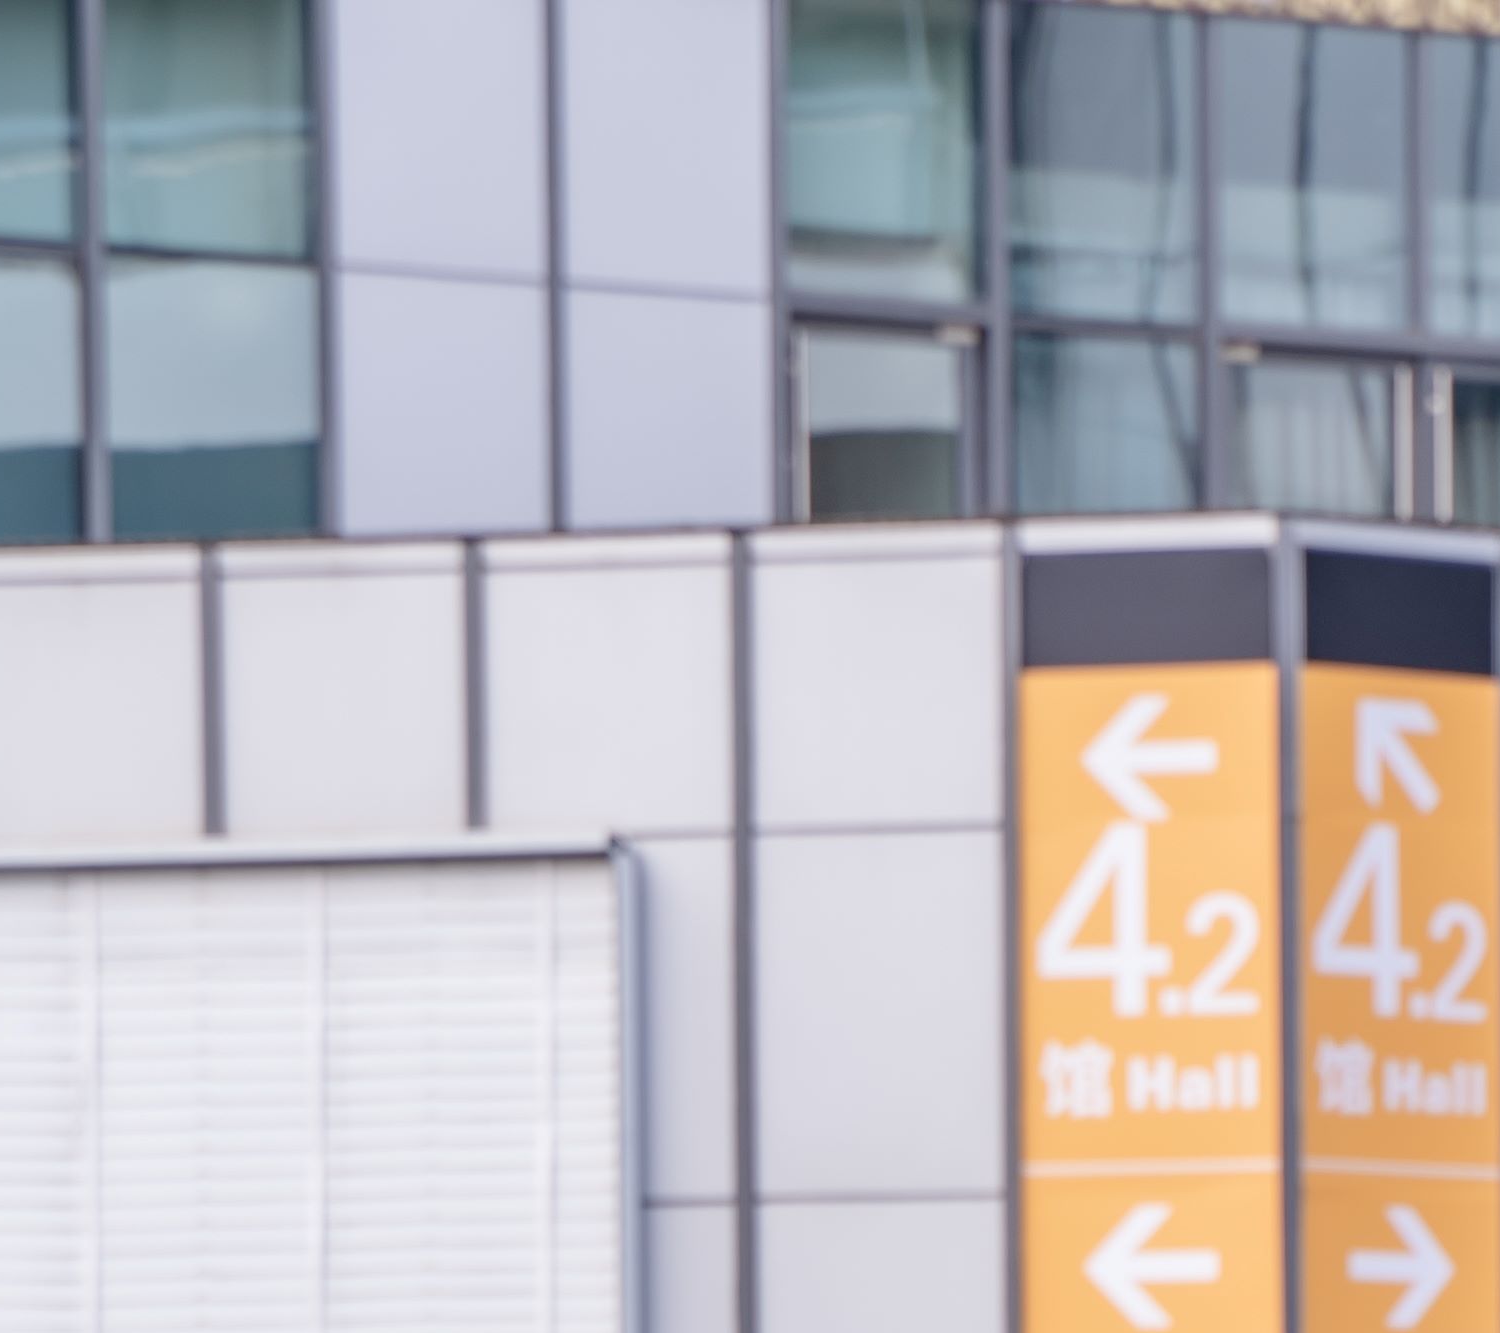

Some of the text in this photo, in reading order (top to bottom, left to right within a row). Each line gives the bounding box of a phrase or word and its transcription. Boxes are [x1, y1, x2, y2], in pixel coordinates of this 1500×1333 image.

[1036, 820, 1262, 1018] 4.2
[1311, 822, 1490, 1023] 4.2
[1041, 1040, 1261, 1120] 馆 Hall
[1316, 1038, 1490, 1117] 馆 Hall
